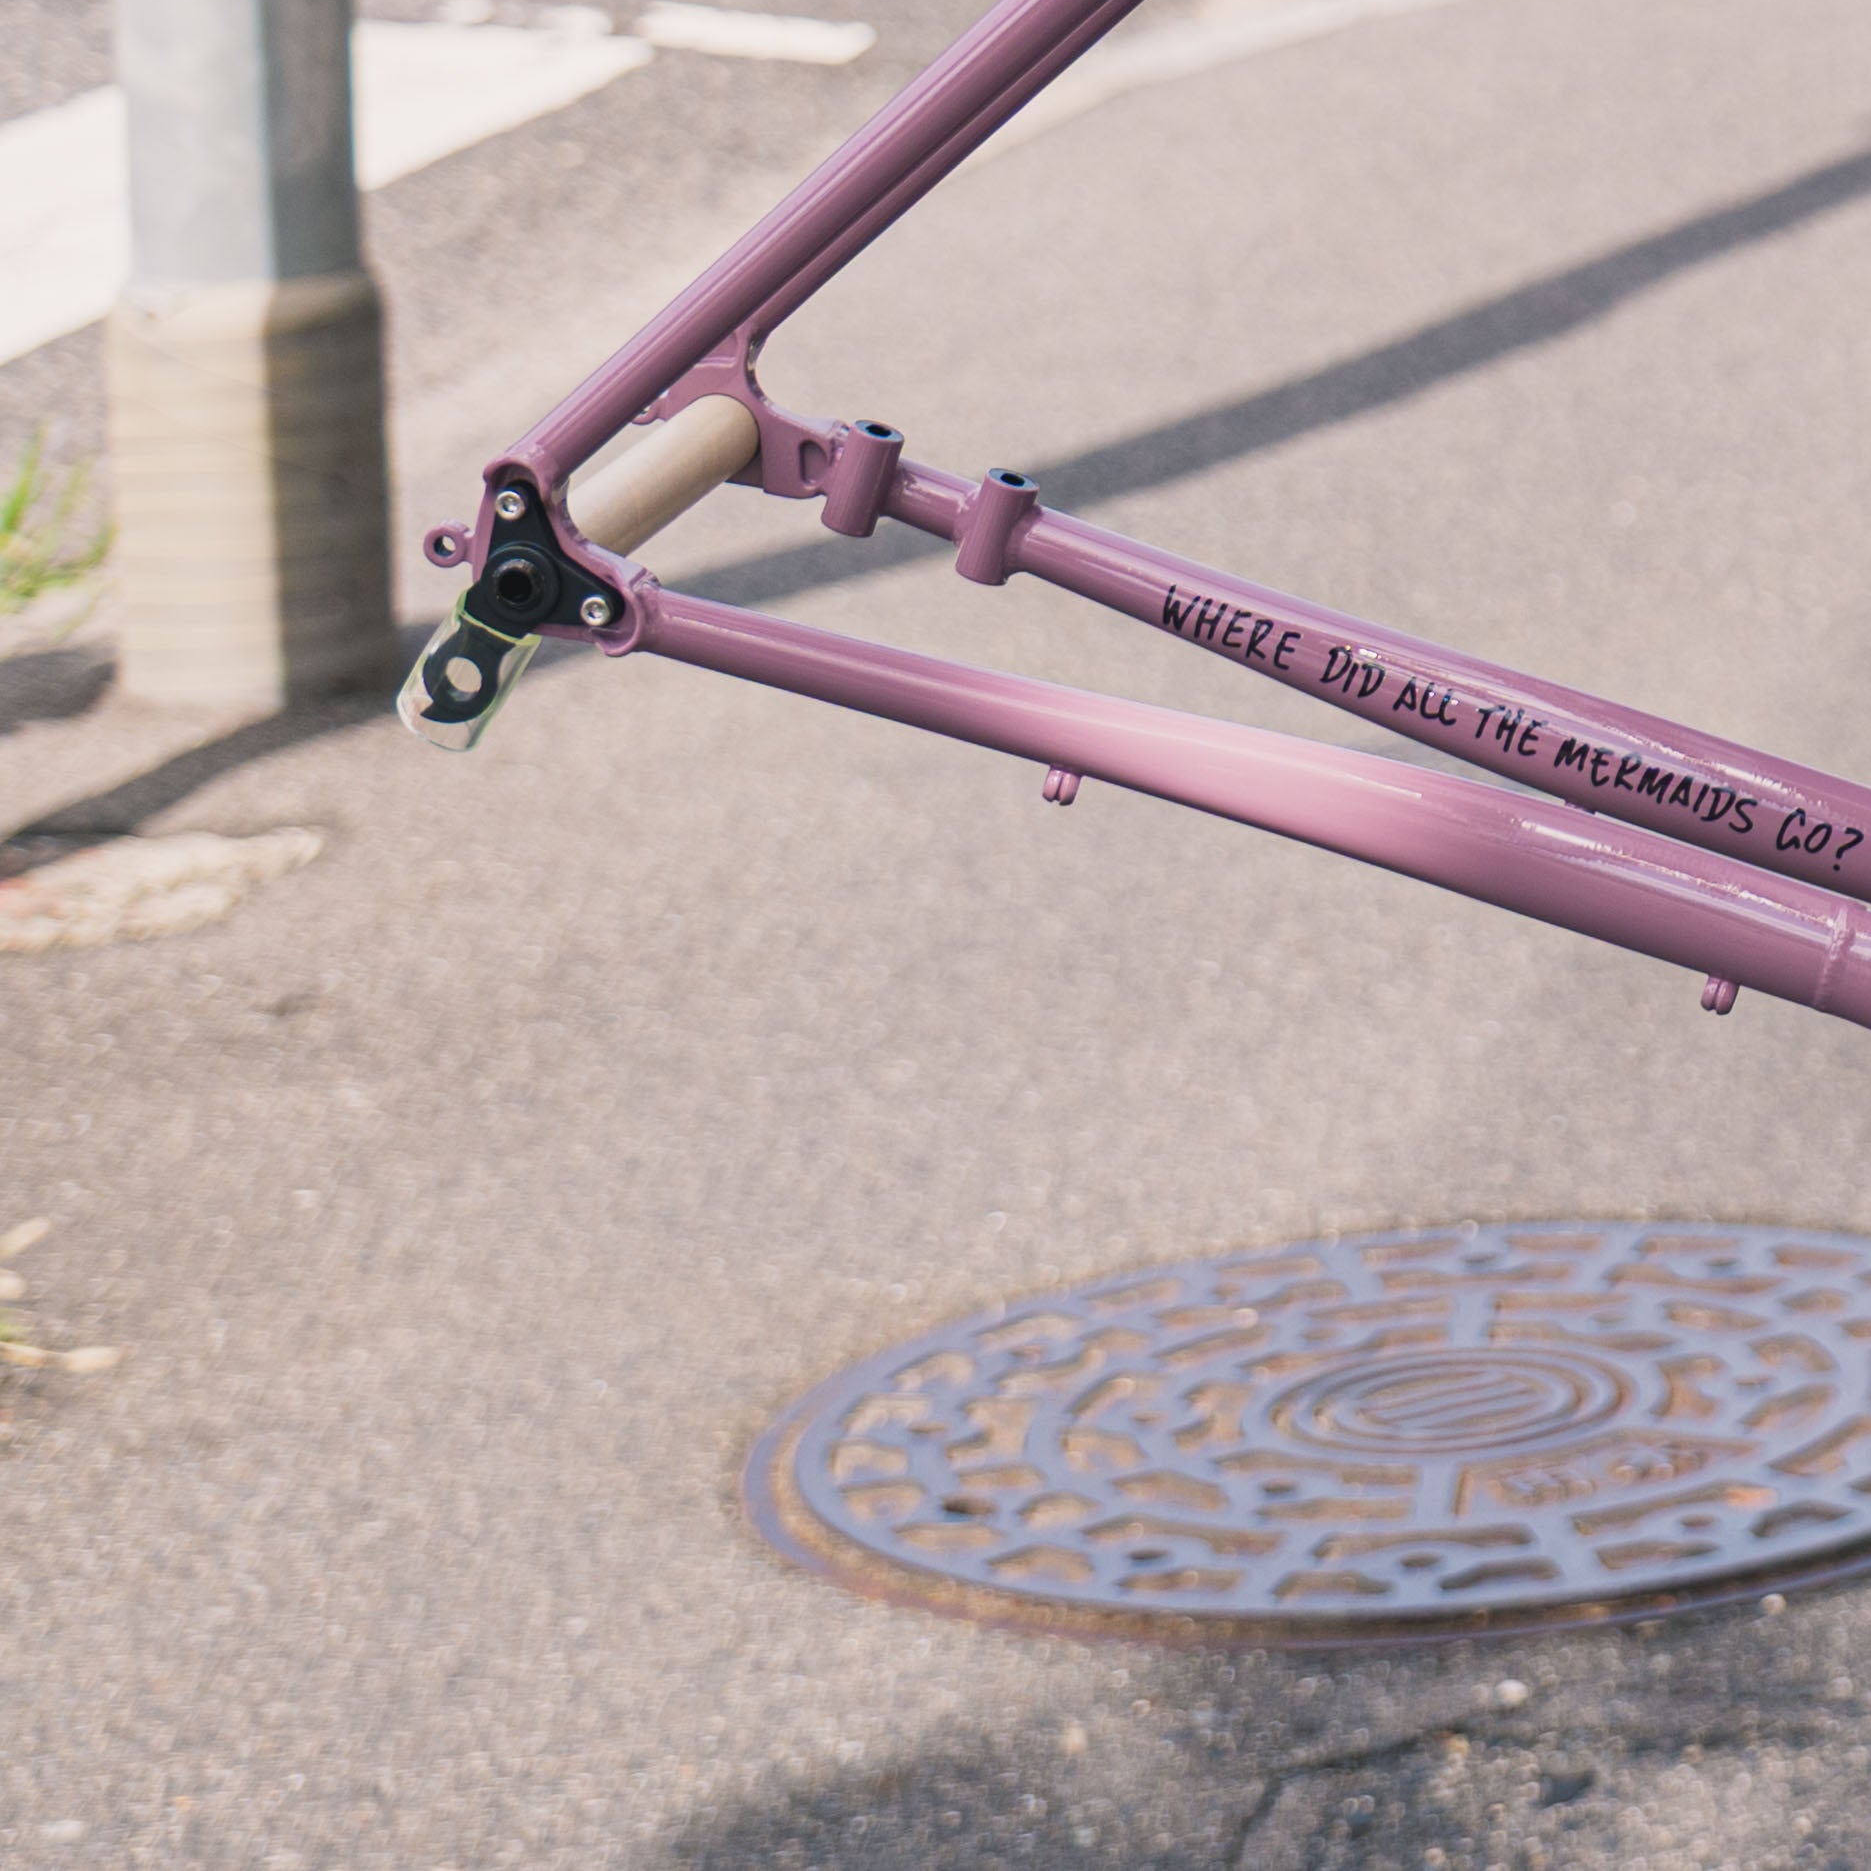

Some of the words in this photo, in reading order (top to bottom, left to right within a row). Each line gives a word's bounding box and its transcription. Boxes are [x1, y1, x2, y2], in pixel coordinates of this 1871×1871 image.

[1162, 584, 1301, 671] WHERE
[1318, 646, 1386, 698] DID
[1392, 676, 1457, 727] ALL
[1474, 704, 1549, 757] THE
[1553, 737, 1758, 834] MERMAIDS
[1775, 807, 1865, 872] GO?
